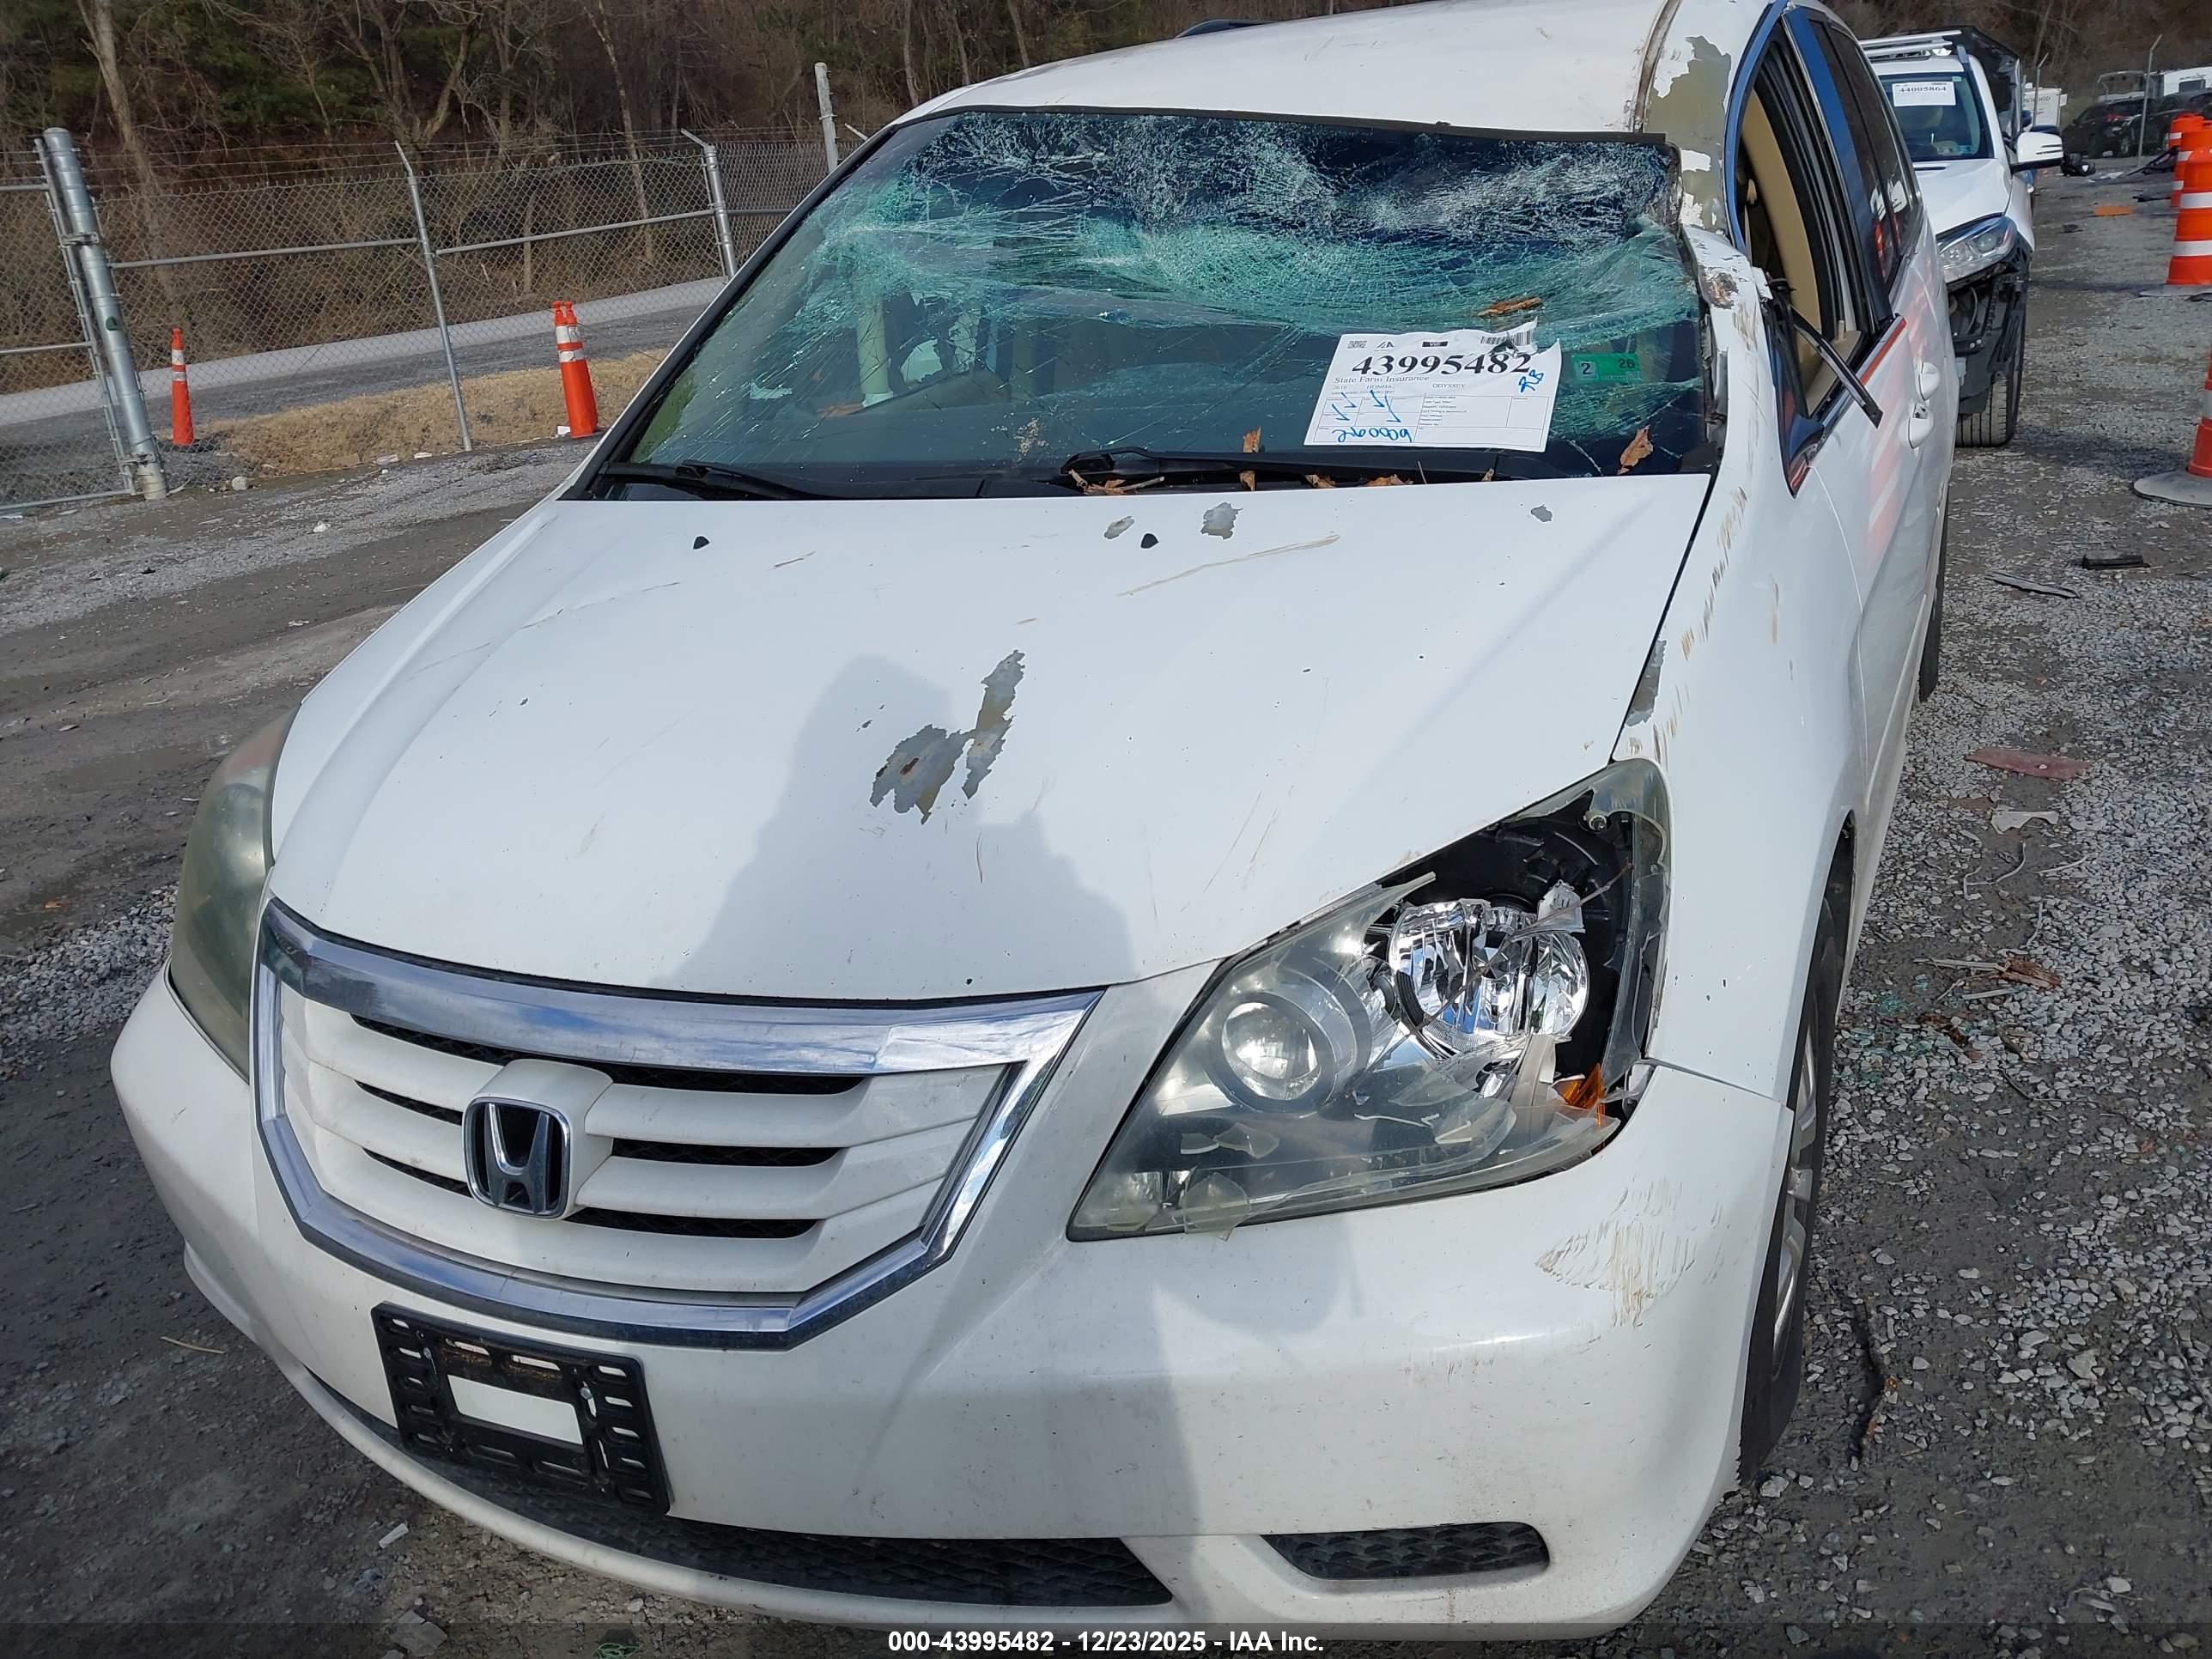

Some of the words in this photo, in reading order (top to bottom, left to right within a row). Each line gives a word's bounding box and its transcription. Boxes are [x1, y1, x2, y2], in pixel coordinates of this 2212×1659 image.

[1352, 353, 1532, 375] 43995482
[1580, 362, 1592, 375] 2
[1618, 358, 1635, 369] 26
